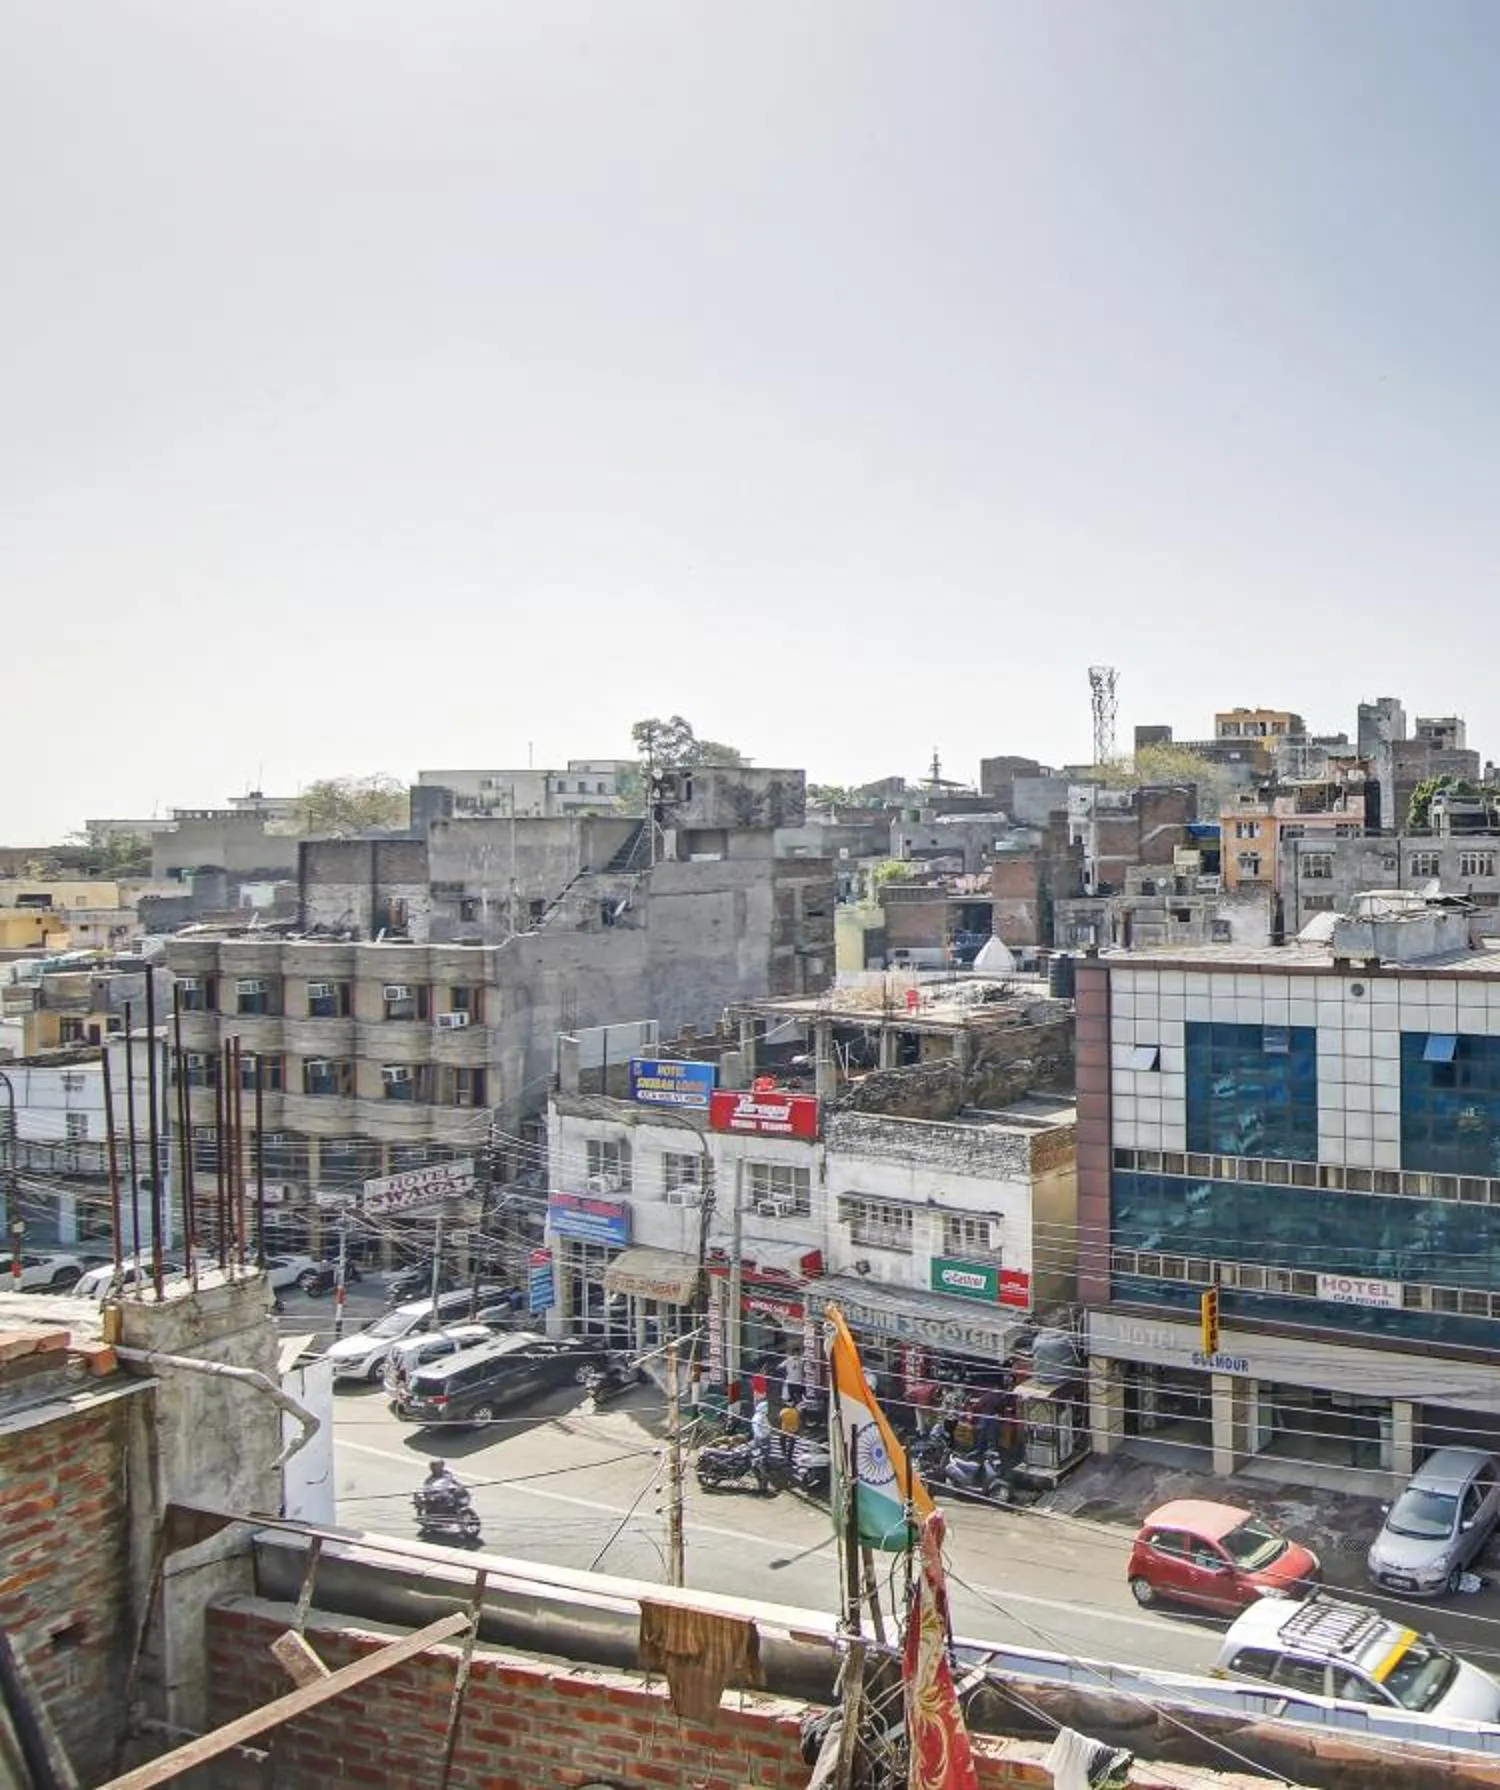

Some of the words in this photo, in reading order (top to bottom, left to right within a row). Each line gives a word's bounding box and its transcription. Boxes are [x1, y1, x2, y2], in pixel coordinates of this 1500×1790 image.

[388, 1167, 453, 1191] HOTEL
[951, 1273, 984, 1288] Castrol
[1321, 1276, 1395, 1298] HOTEL
